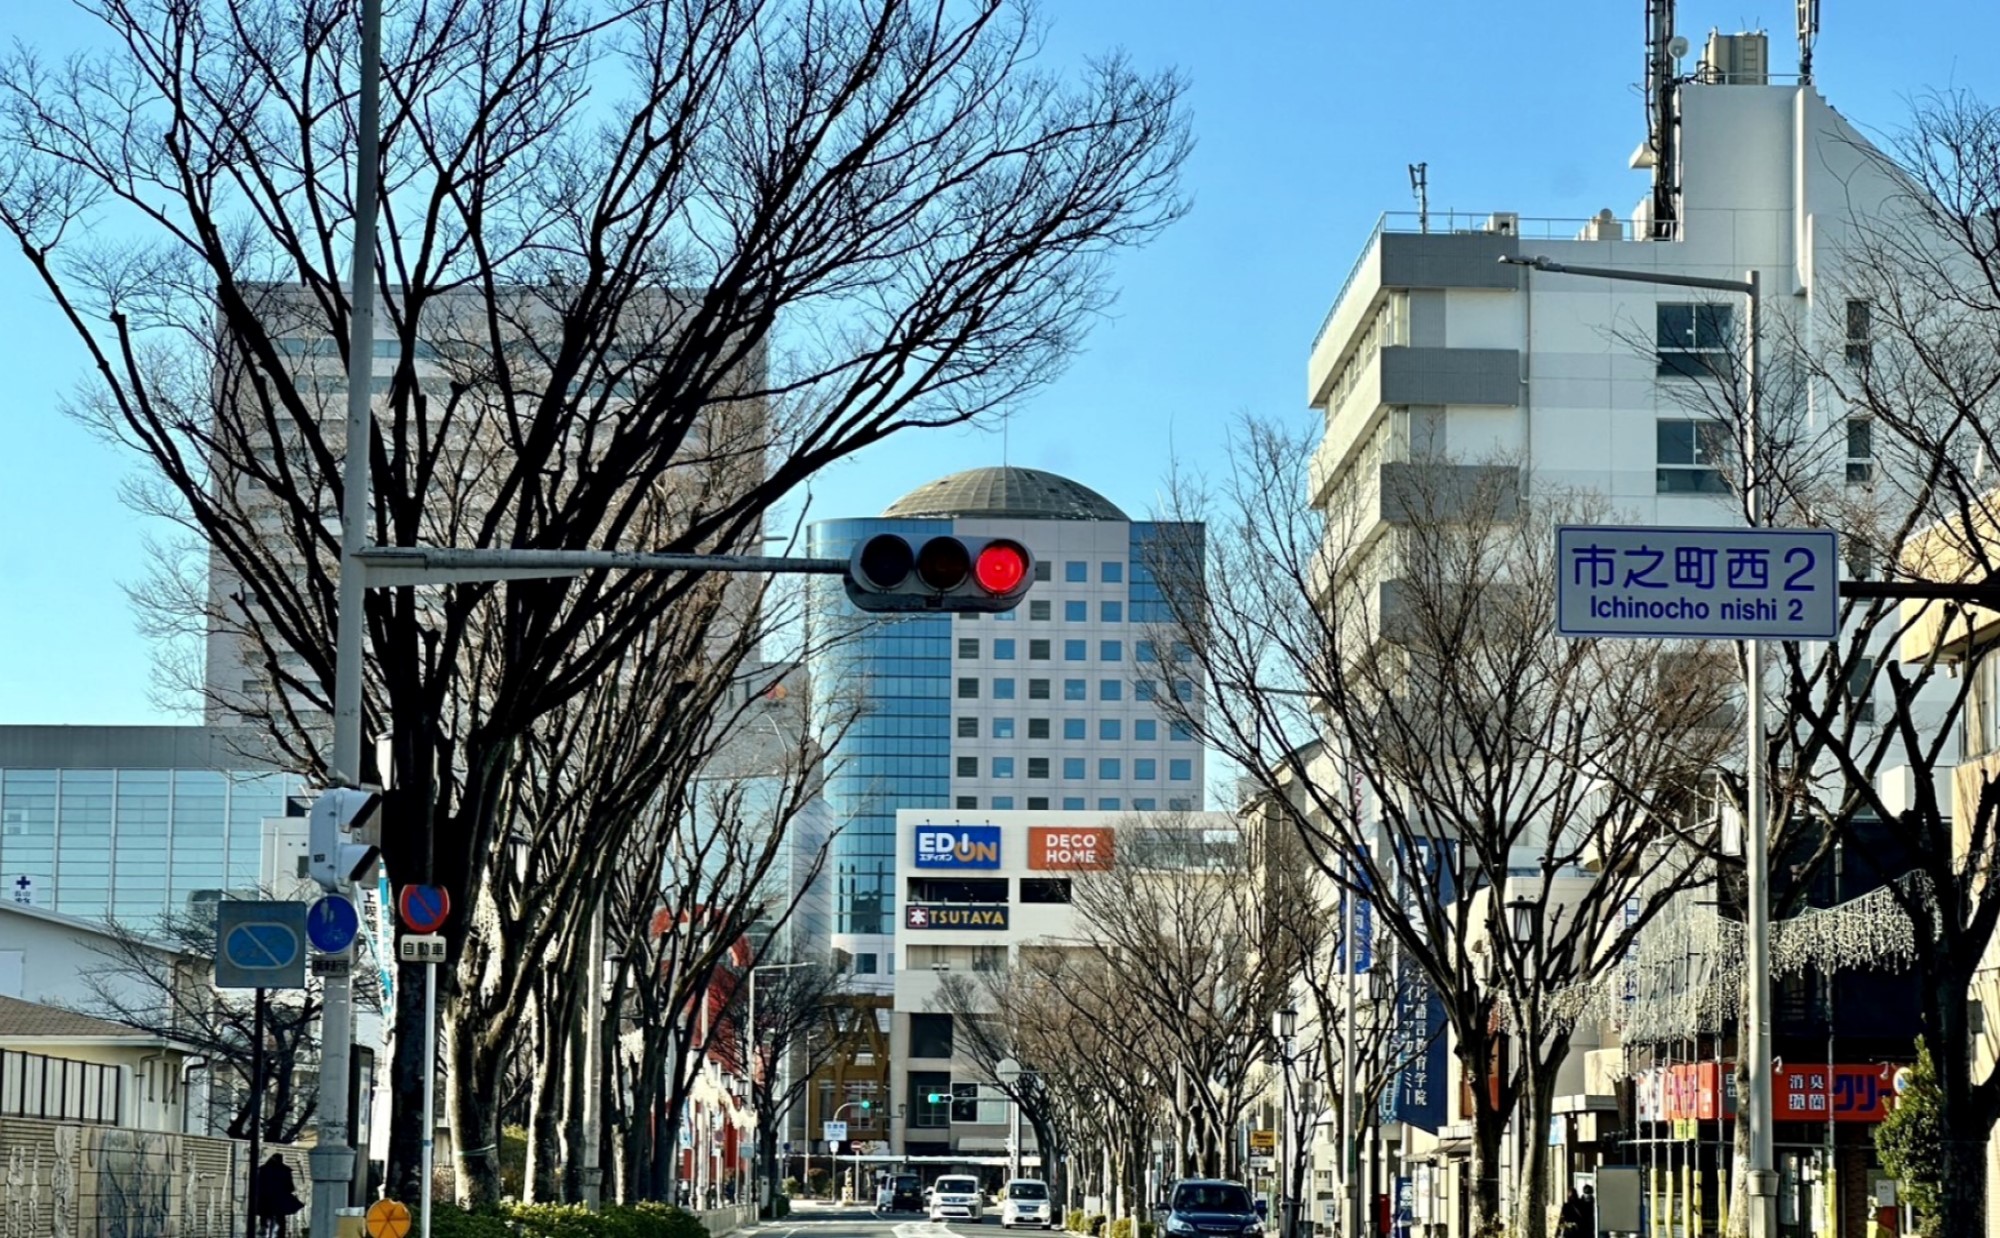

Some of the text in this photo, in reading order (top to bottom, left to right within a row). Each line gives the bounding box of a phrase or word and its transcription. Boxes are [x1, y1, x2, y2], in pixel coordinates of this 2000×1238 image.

[1572, 544, 1815, 591] 市之町西2
[1591, 595, 1804, 621] Ichinocho nishi 2
[919, 832, 997, 862] EDION
[1046, 834, 1096, 848] DECO
[1046, 850, 1096, 863] HOME
[929, 910, 1004, 925] TSUTAYA
[403, 942, 444, 956] 自動車
